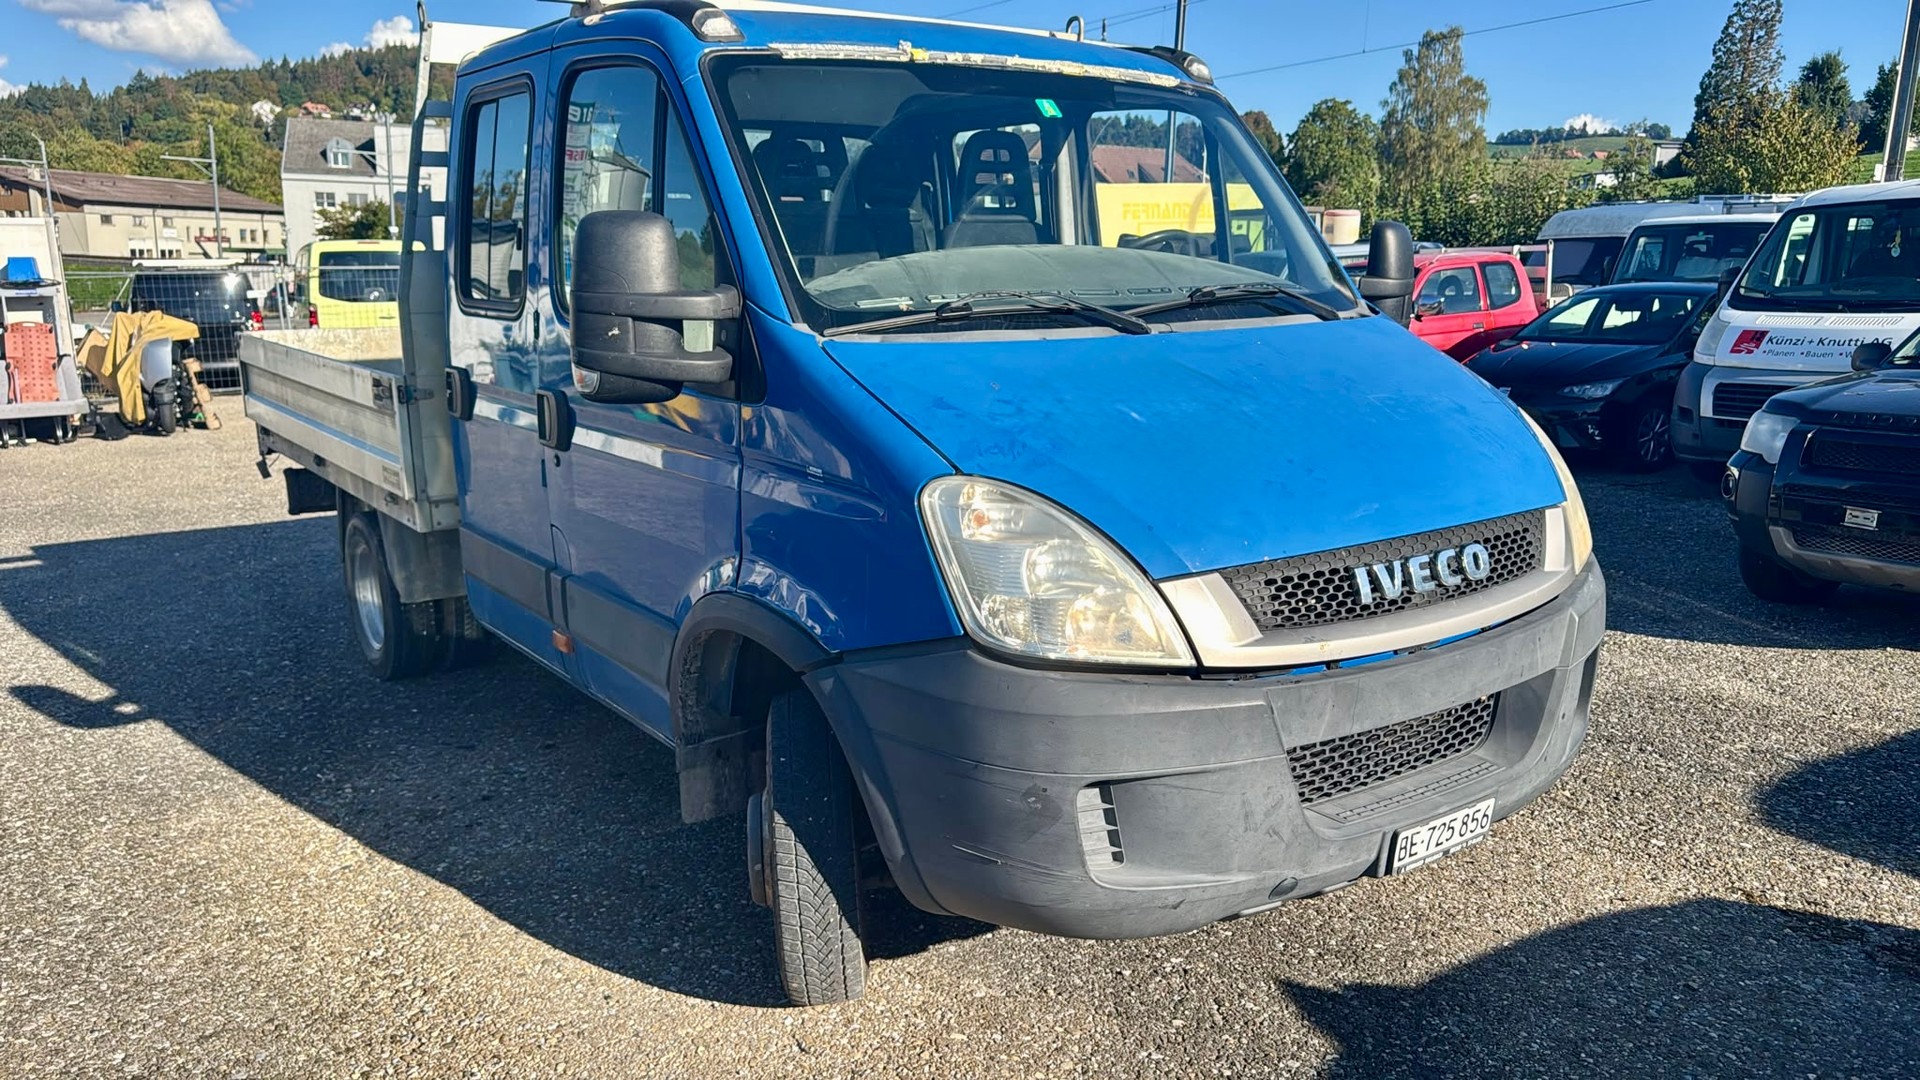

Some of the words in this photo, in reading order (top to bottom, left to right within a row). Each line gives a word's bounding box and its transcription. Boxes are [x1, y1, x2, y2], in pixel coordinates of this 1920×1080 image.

[1766, 335, 1806, 346] Künzi
[1817, 336, 1866, 347] Knutti
[1871, 337, 1893, 346] AG
[1766, 349, 1795, 357] Planen
[1805, 350, 1833, 358] Bauen
[1353, 542, 1490, 605] IVECO
